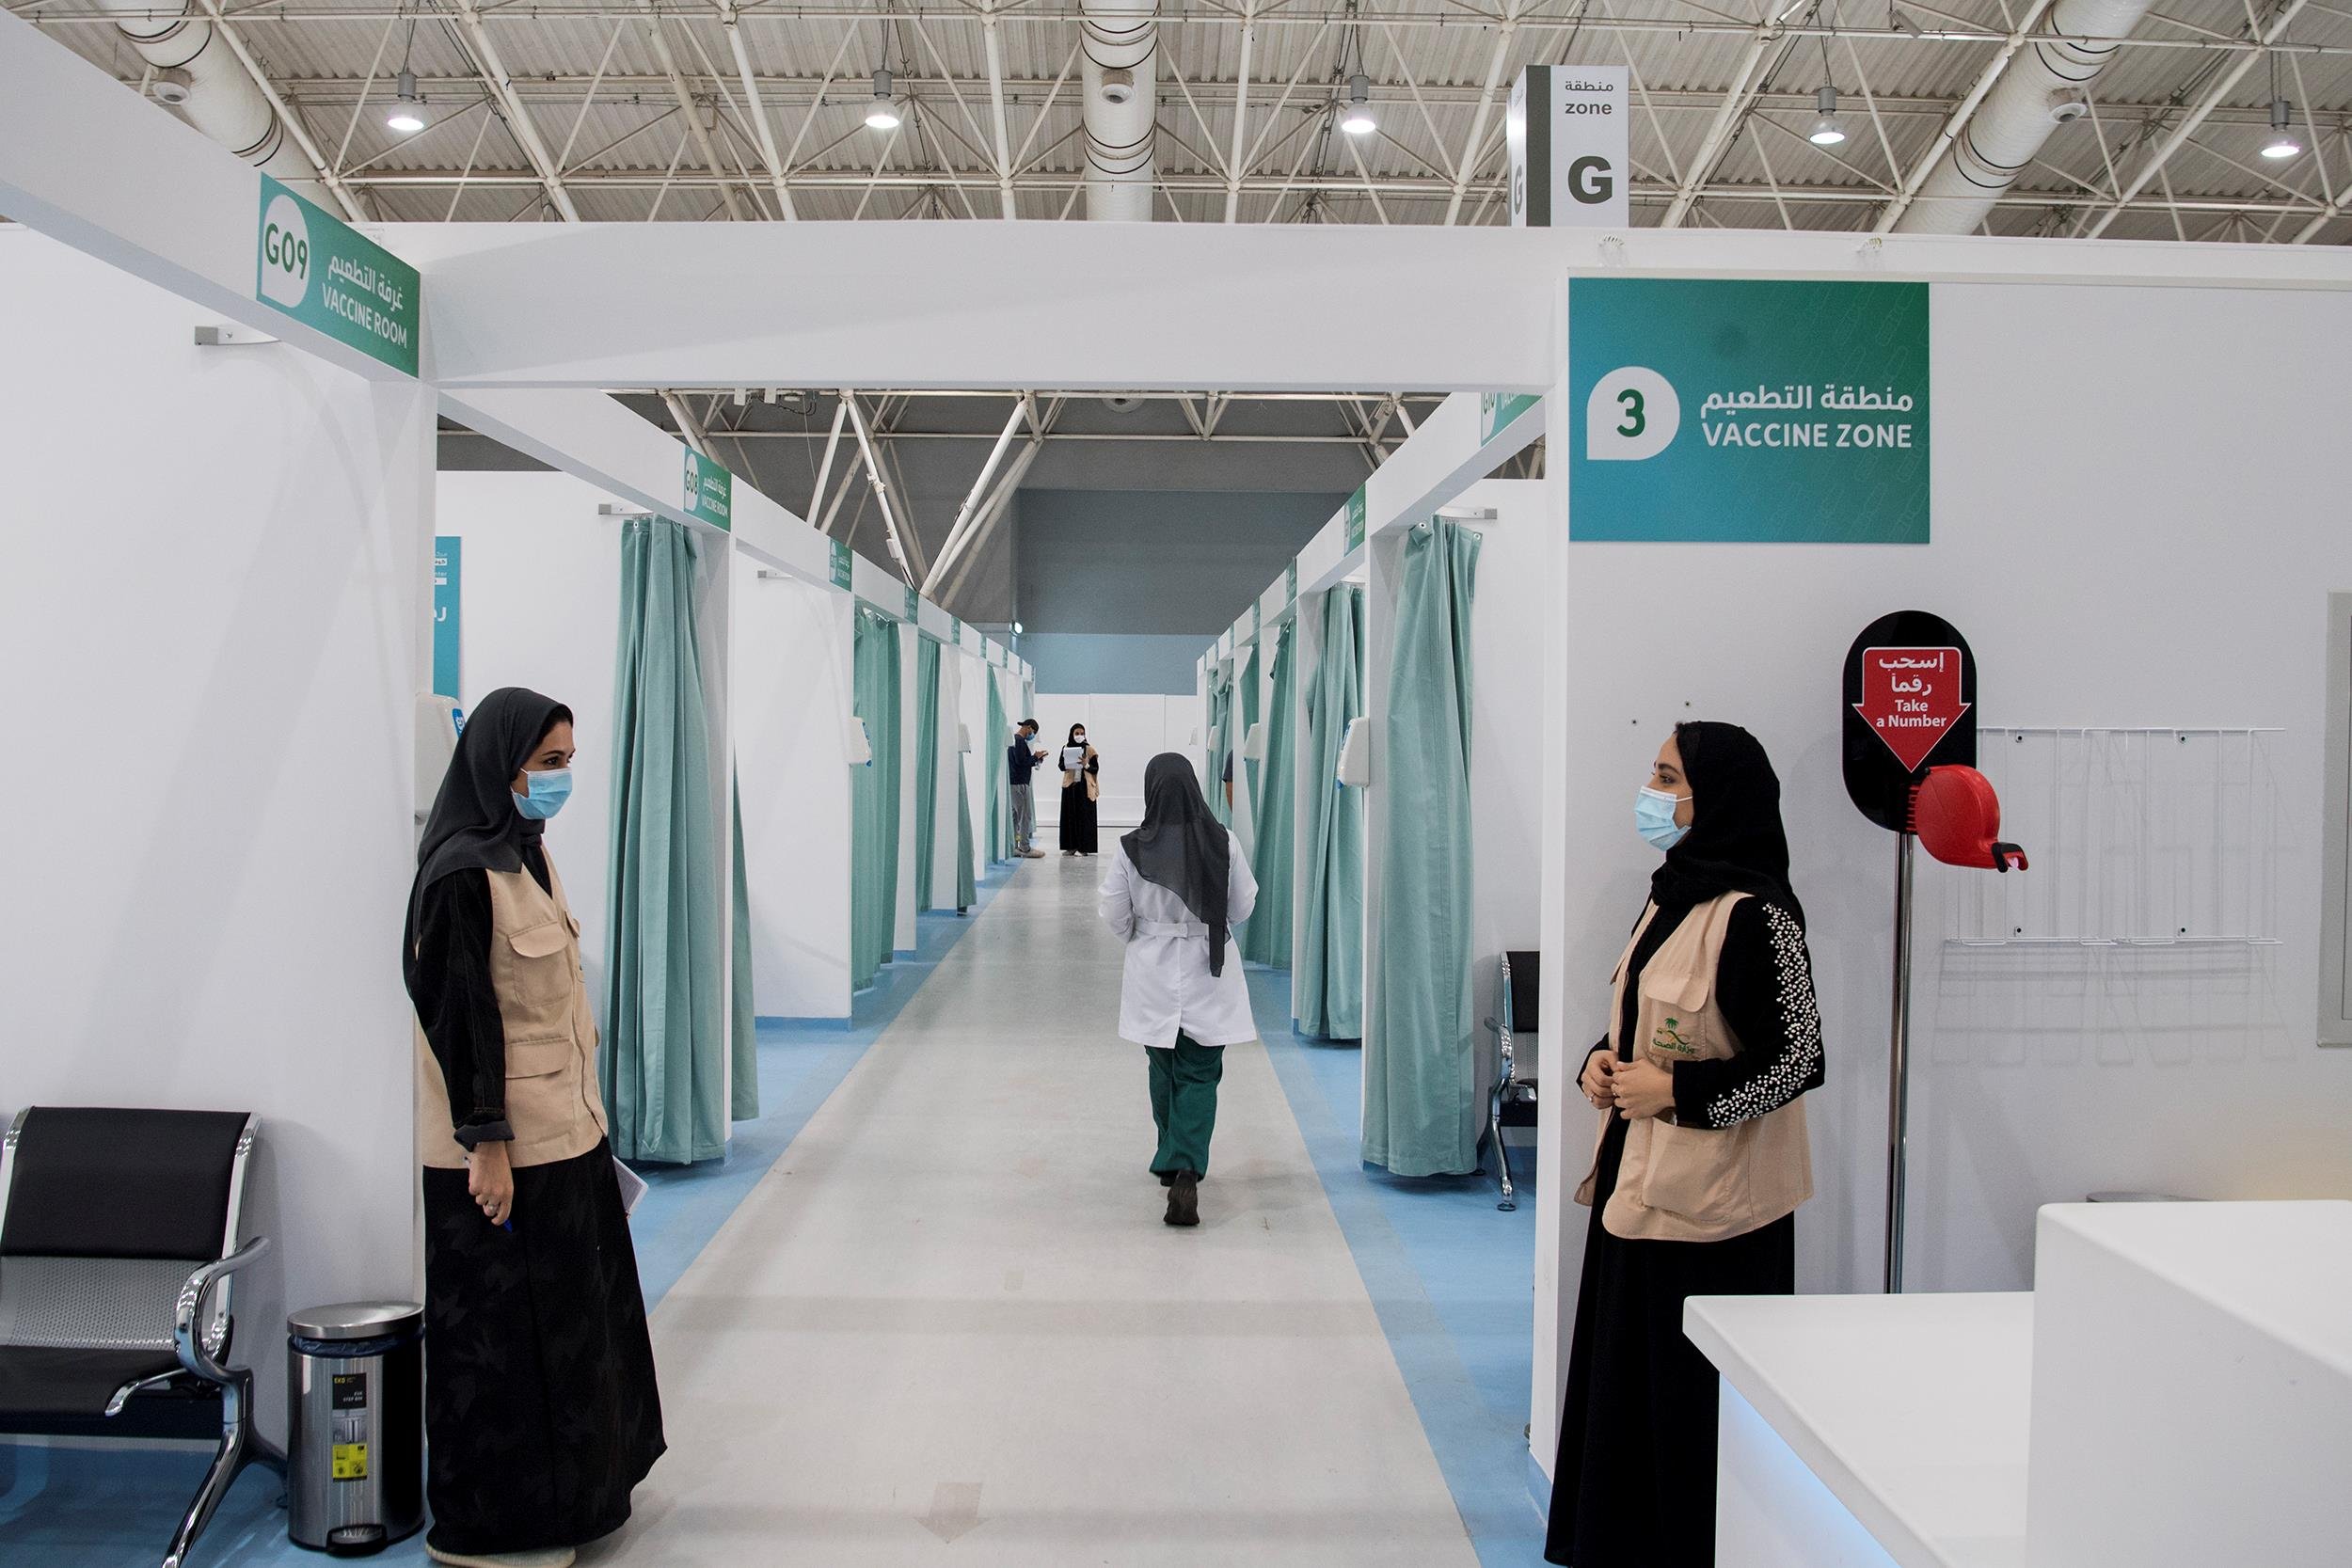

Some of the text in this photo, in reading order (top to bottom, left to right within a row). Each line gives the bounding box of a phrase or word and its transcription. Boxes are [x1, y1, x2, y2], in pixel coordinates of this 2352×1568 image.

[1565, 81, 1613, 92] منطقة
[1565, 103, 1613, 115] zone
[1514, 164, 1523, 215] G
[1567, 155, 1613, 204] G
[265, 223, 308, 280] G09
[328, 254, 405, 312] غرفة التطعيم
[322, 282, 407, 349] VACCINE ROOM
[1616, 388, 1646, 438] 3
[1700, 384, 1914, 420] منطقة التطعيم
[1701, 422, 1913, 448] VACCINE ZONE
[1879, 652, 1944, 673] إسحب
[1876, 714, 1947, 727] a Number
[1895, 699, 1929, 712] Take
